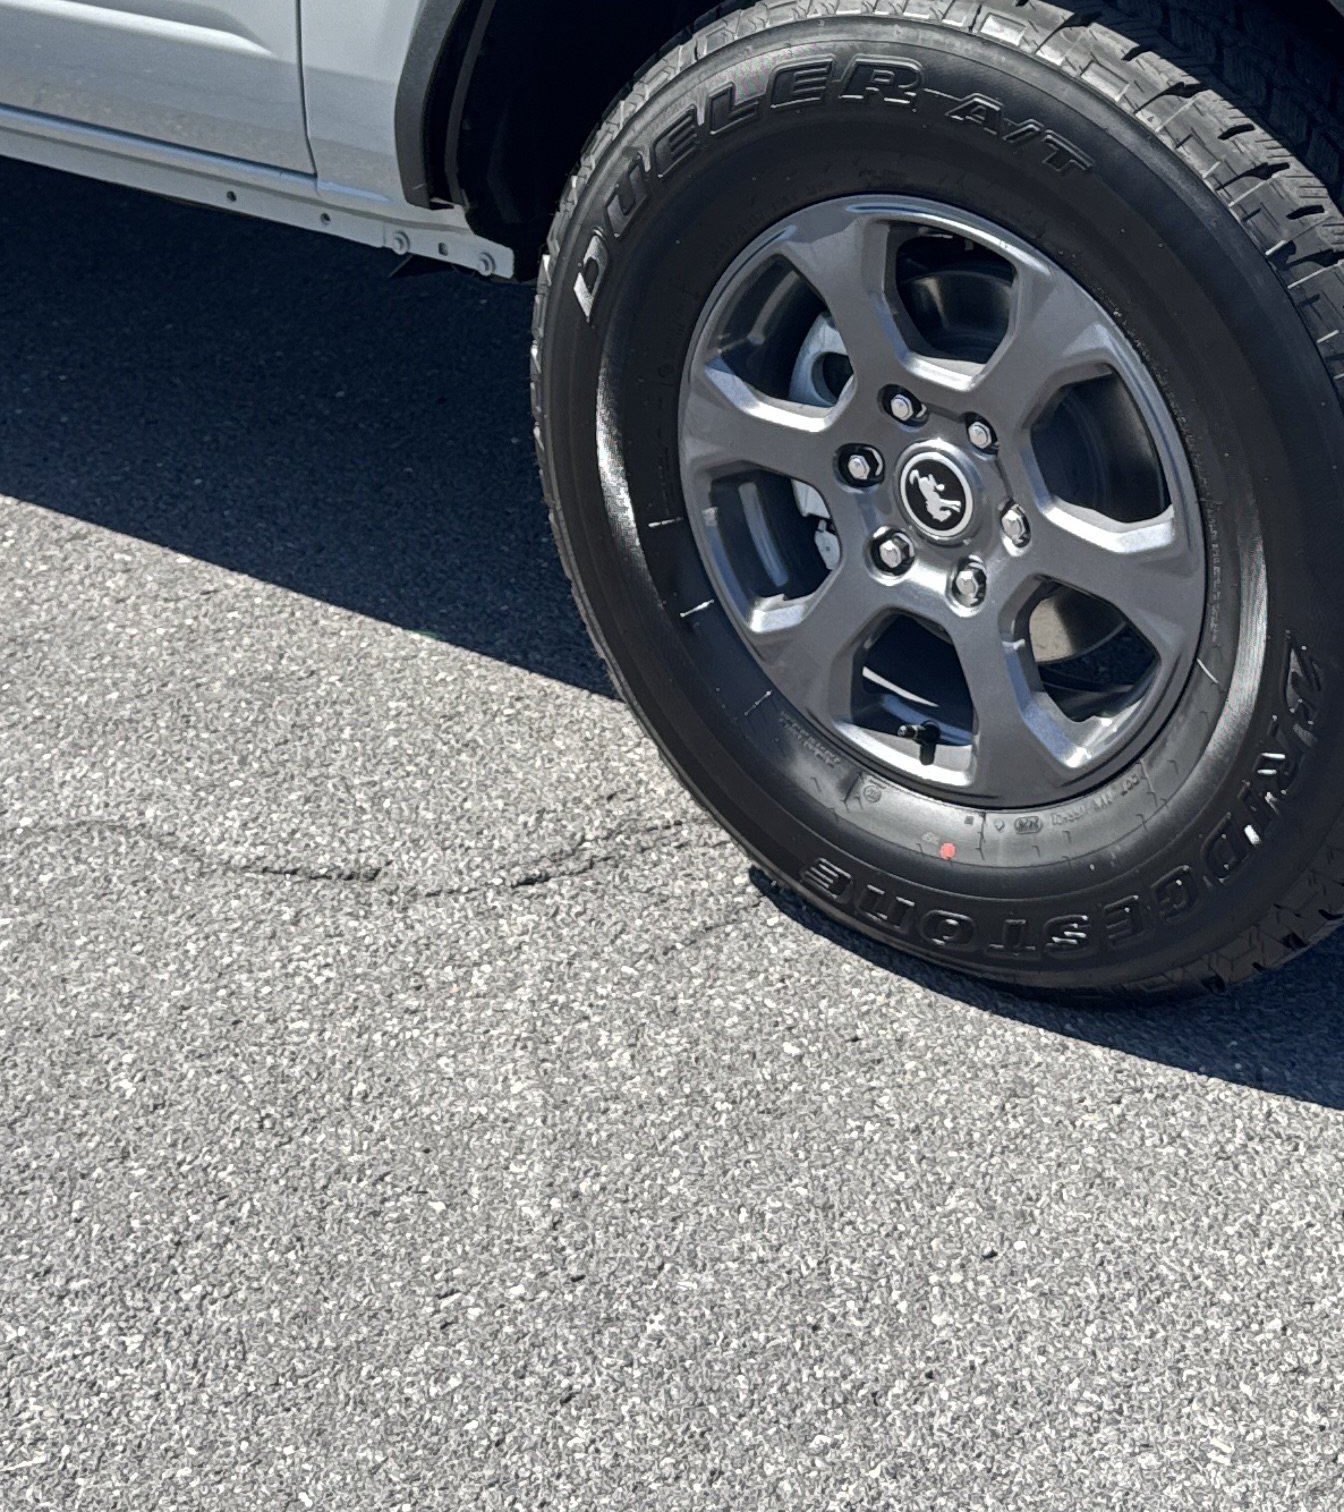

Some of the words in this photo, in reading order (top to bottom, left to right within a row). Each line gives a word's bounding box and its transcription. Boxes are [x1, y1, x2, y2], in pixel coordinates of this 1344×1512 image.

[573, 53, 923, 324] DUELER
[944, 91, 1096, 174] A/T
[799, 631, 1324, 960] BRIDGESTONE
